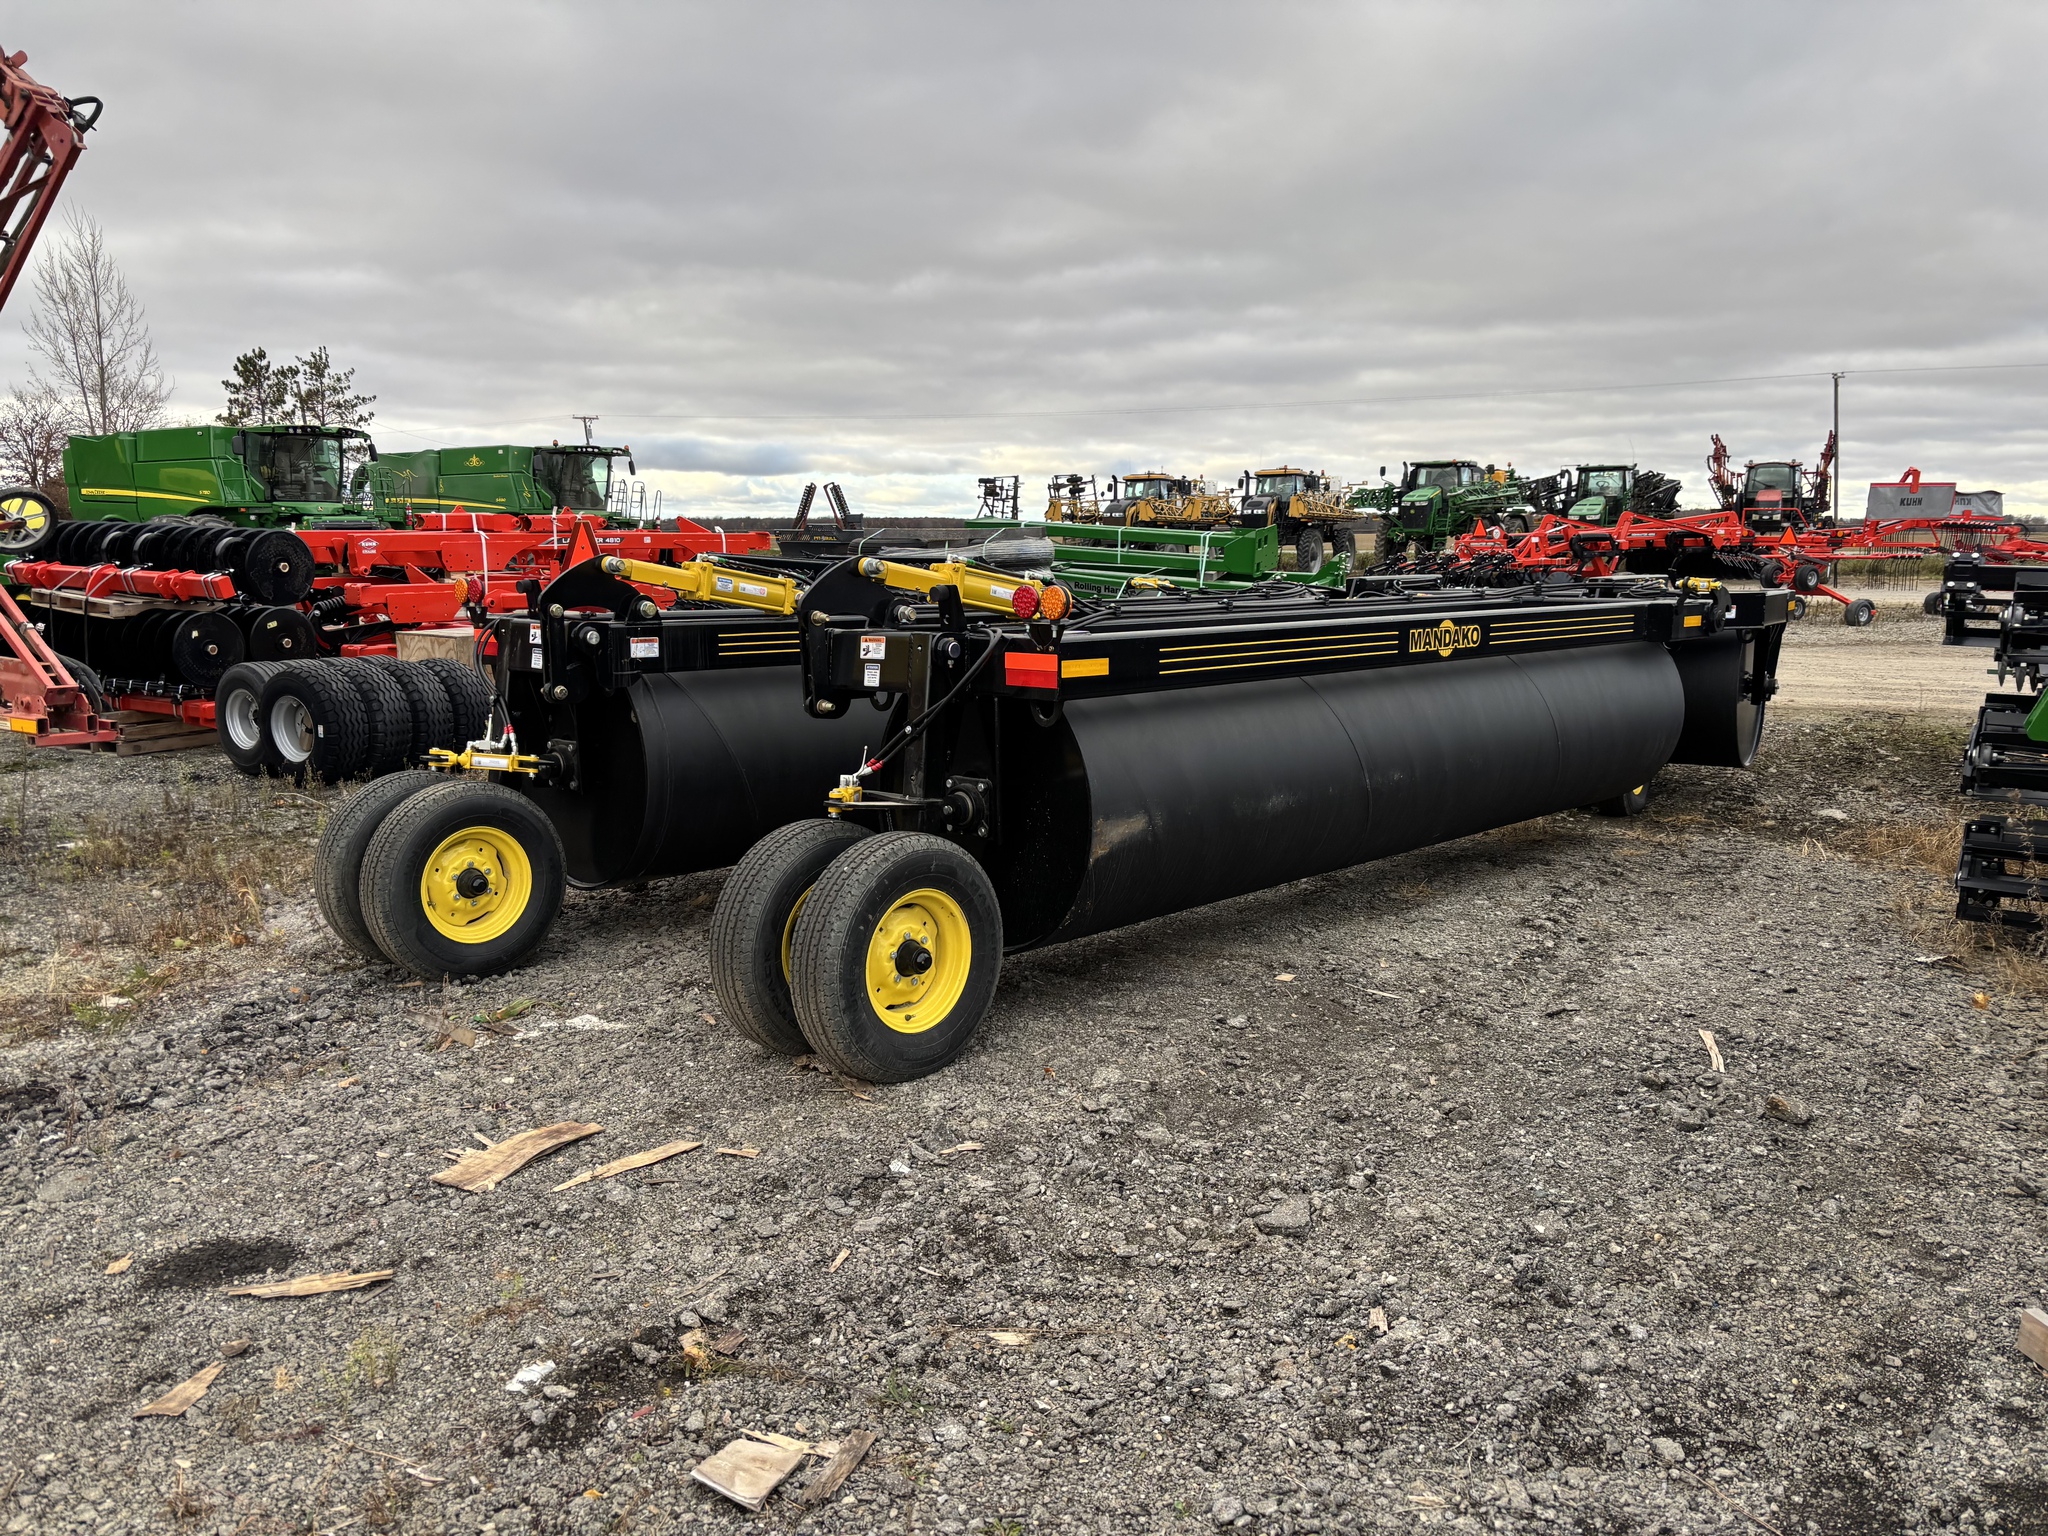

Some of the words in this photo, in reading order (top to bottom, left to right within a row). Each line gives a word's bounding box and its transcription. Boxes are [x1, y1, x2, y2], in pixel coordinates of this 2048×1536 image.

[1900, 497, 1923, 506] KUHN
[1954, 497, 1972, 506] KUH
[1074, 581, 1102, 594] Rolling
[1409, 625, 1481, 652] MANDAKO
